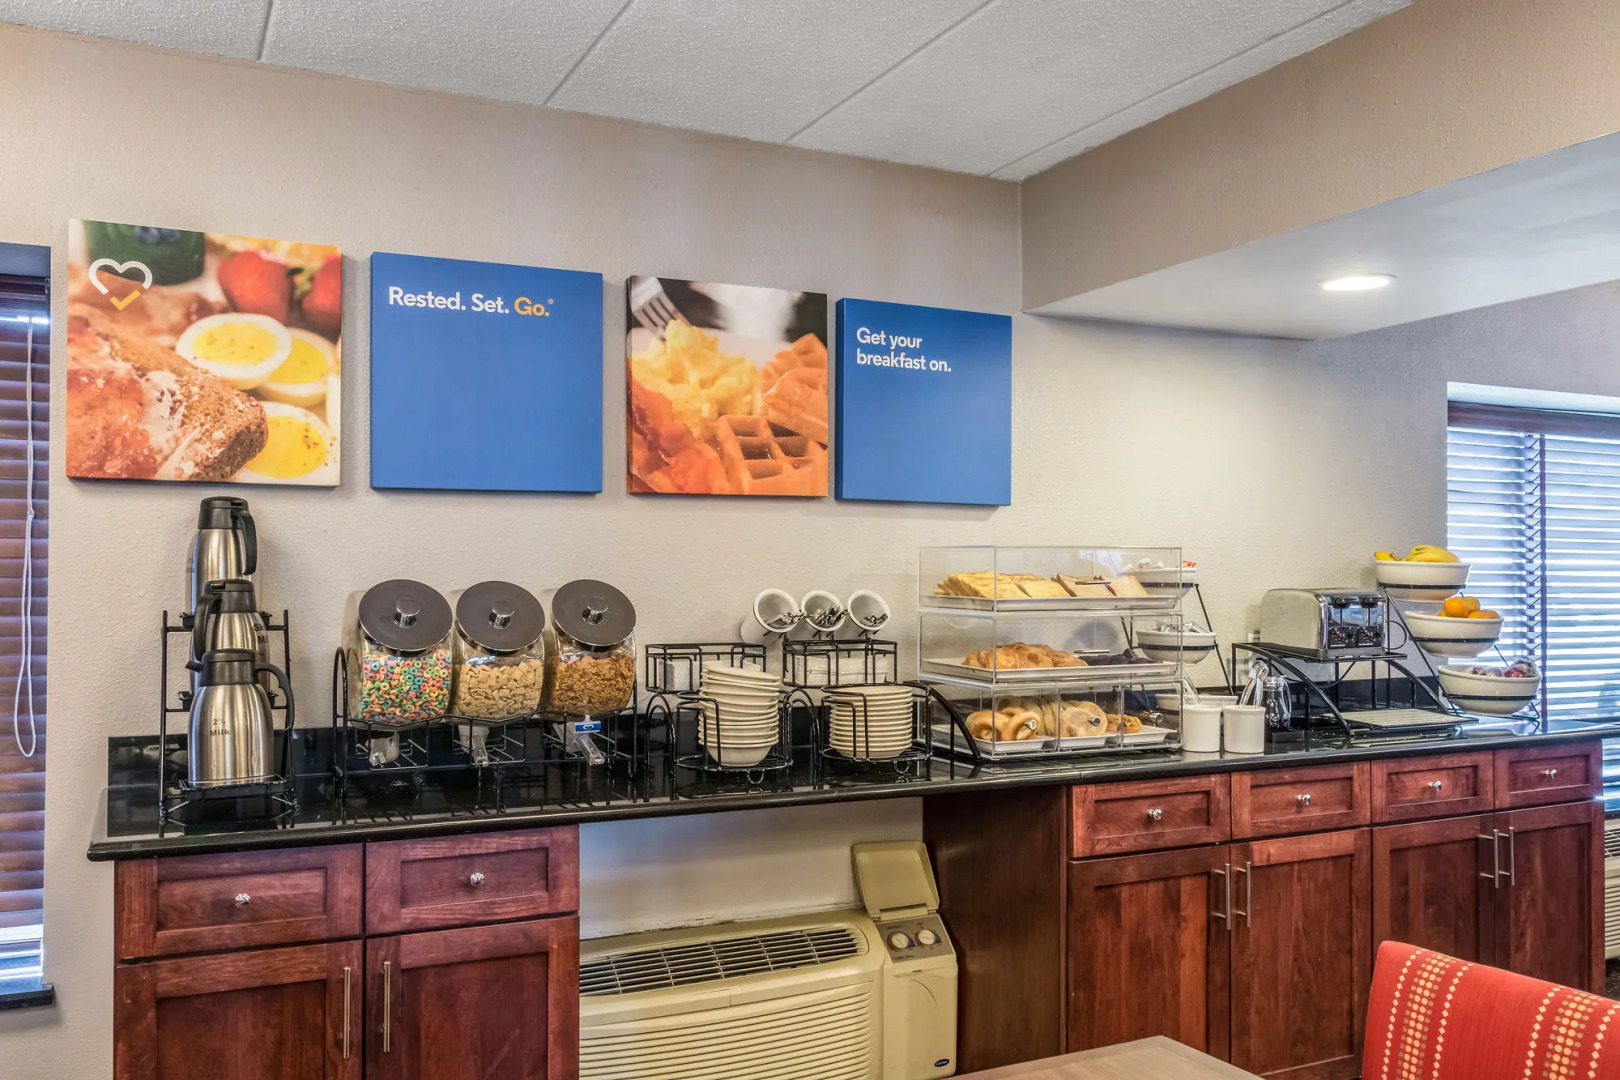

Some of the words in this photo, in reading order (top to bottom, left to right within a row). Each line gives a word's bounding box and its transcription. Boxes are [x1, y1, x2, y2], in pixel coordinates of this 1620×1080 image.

[388, 286, 466, 311] Rested.
[471, 293, 510, 314] Set.
[856, 327, 886, 346] Get
[889, 335, 922, 350] your
[856, 348, 926, 370] breakfast
[929, 359, 952, 373] on.
